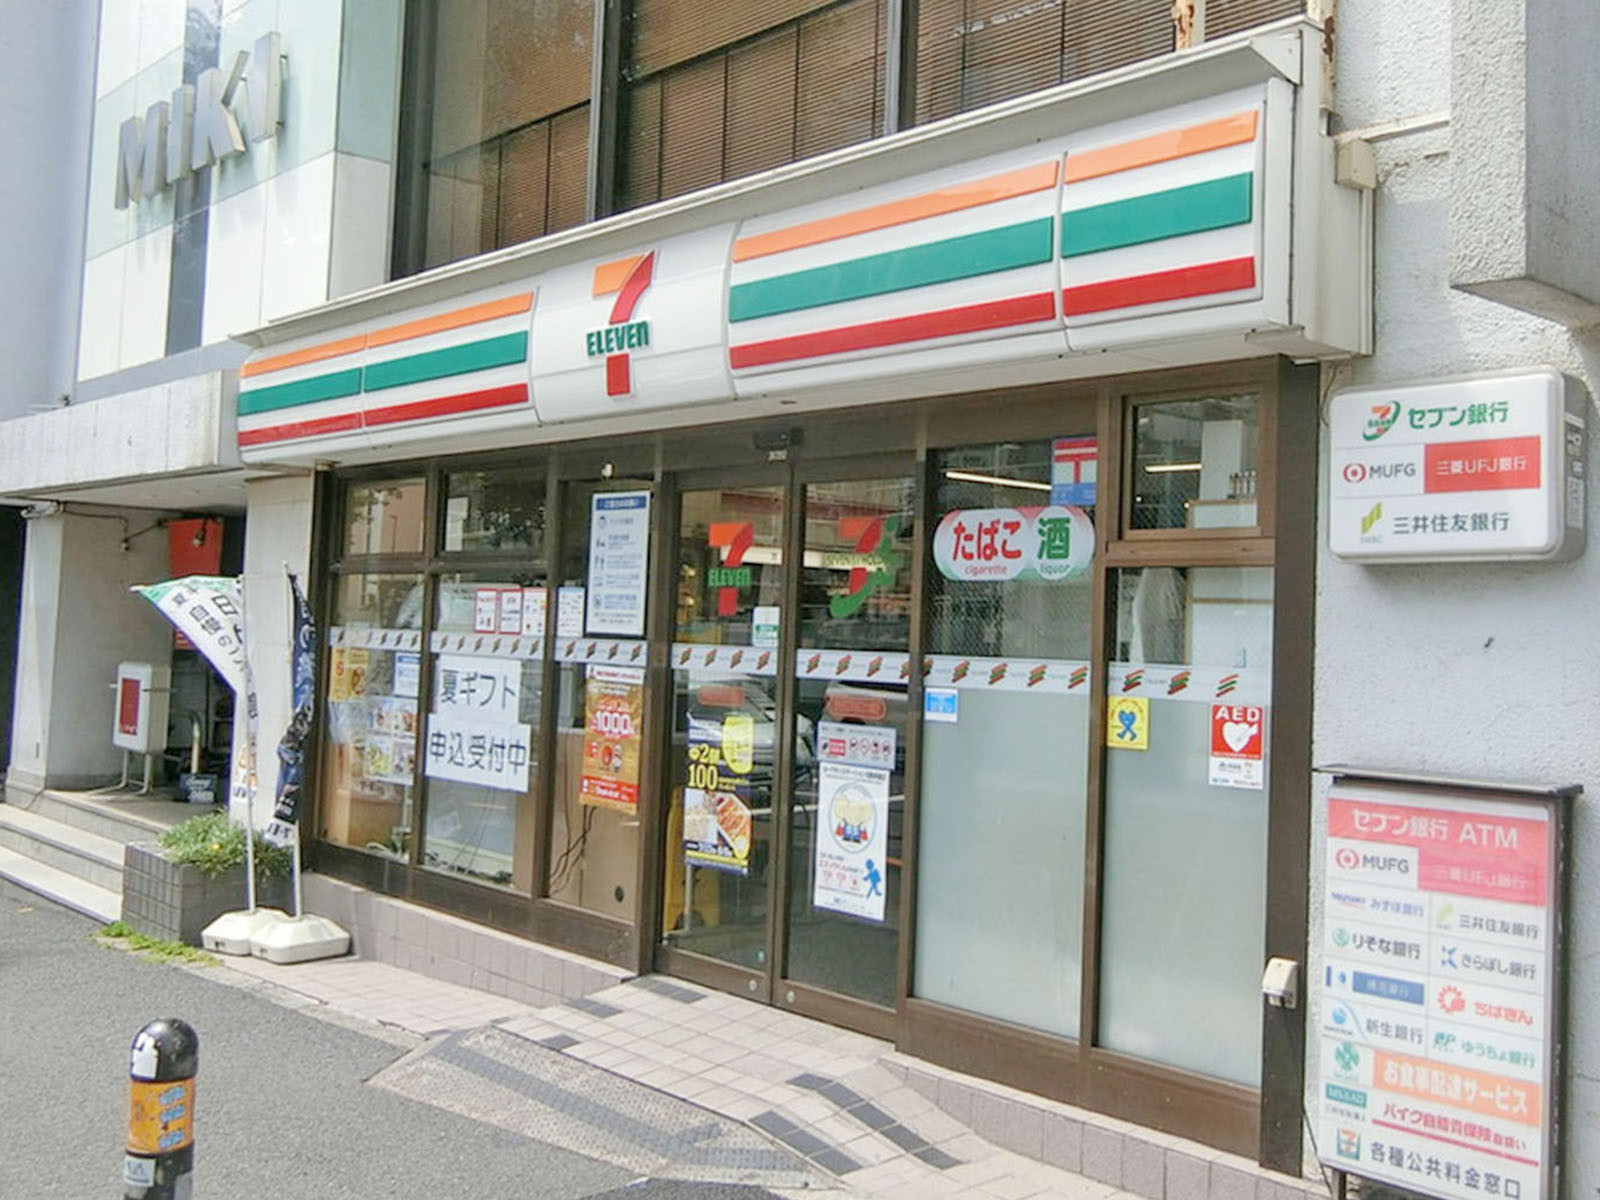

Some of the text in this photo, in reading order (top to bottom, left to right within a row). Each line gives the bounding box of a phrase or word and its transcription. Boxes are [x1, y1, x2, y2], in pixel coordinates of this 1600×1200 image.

[115, 31, 282, 211] MIKI
[593, 250, 655, 396] 7
[1408, 402, 1508, 429] セブン銀行
[1369, 463, 1416, 478] MUFG
[1436, 456, 1528, 475] 三菱UFJ銀行
[1393, 512, 1510, 535] 三井住友銀行
[953, 517, 1071, 561] たばこ 酒
[441, 668, 516, 711] 夏ギフト
[1215, 706, 1260, 722] AED
[430, 729, 527, 775] 申込受付中
[1353, 809, 1518, 849] セブン銀行 ATM
[1362, 855, 1409, 874] MUFG
[1459, 914, 1539, 939] 三井住友銀行
[1352, 932, 1421, 960] りそな銀行
[1461, 953, 1536, 980] きらぼし銀行
[1366, 1018, 1423, 1045] 新生銀行
[1461, 1041, 1535, 1068] ゆうちょ銀行
[1371, 1142, 1521, 1199] 各種公共料金窓口
